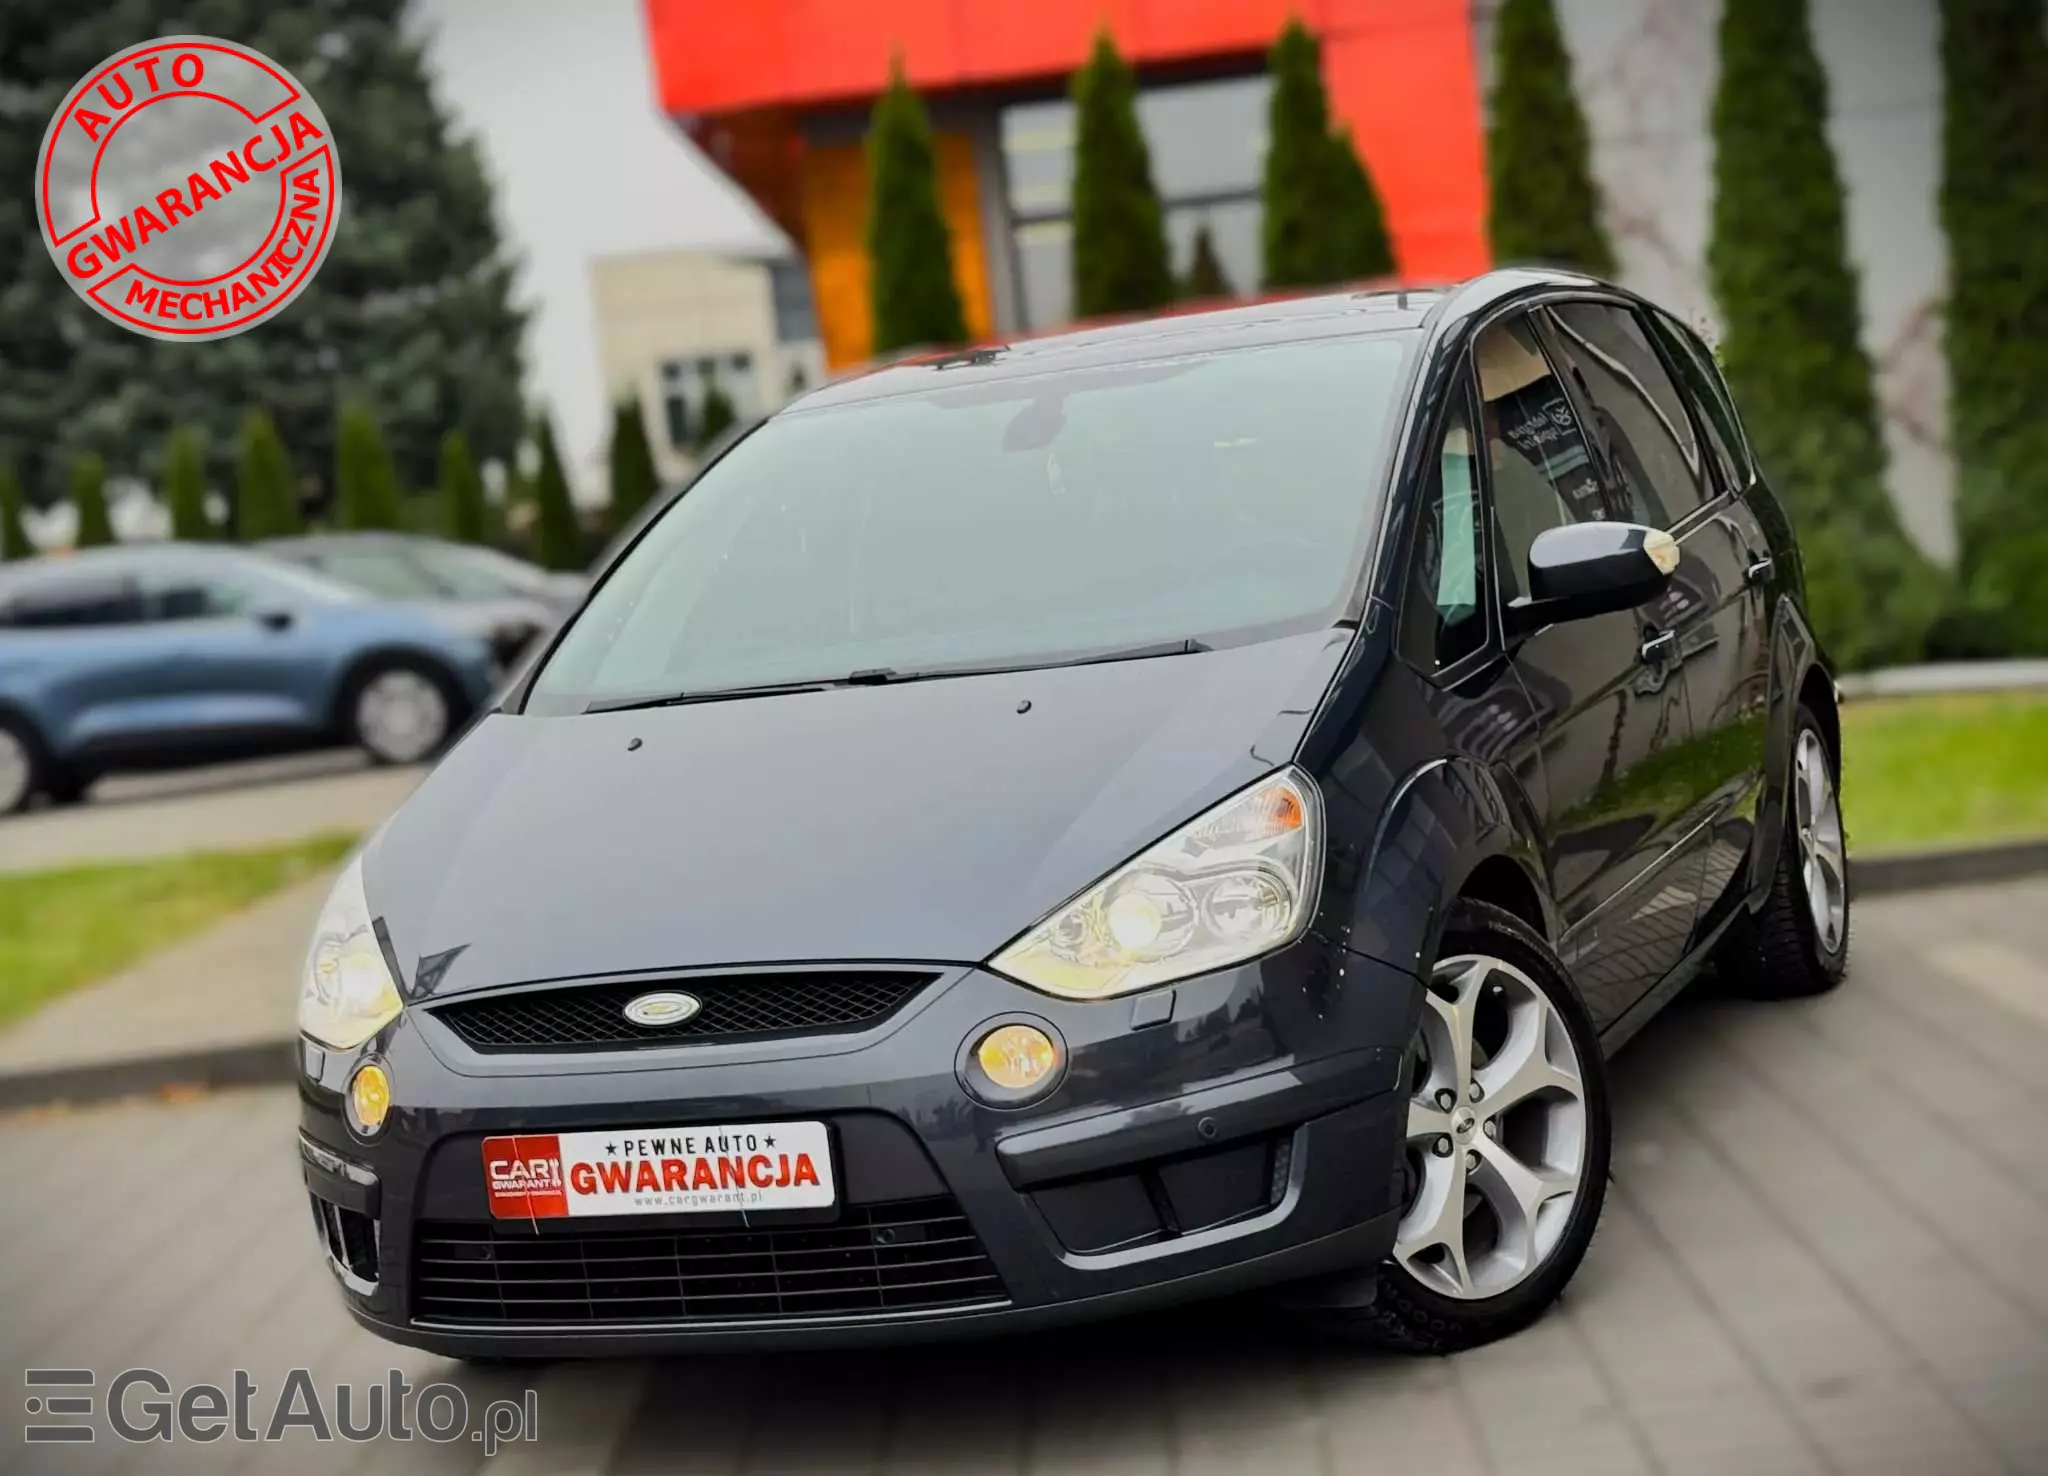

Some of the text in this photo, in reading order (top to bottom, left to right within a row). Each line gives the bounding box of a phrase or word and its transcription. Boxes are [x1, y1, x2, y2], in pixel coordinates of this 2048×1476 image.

[623, 1134, 758, 1157] PEWNE AUTO
[488, 1158, 551, 1181] CAR
[569, 1152, 821, 1196] GWARANCJA
[633, 1190, 764, 1207] www.cargwarant.pl
